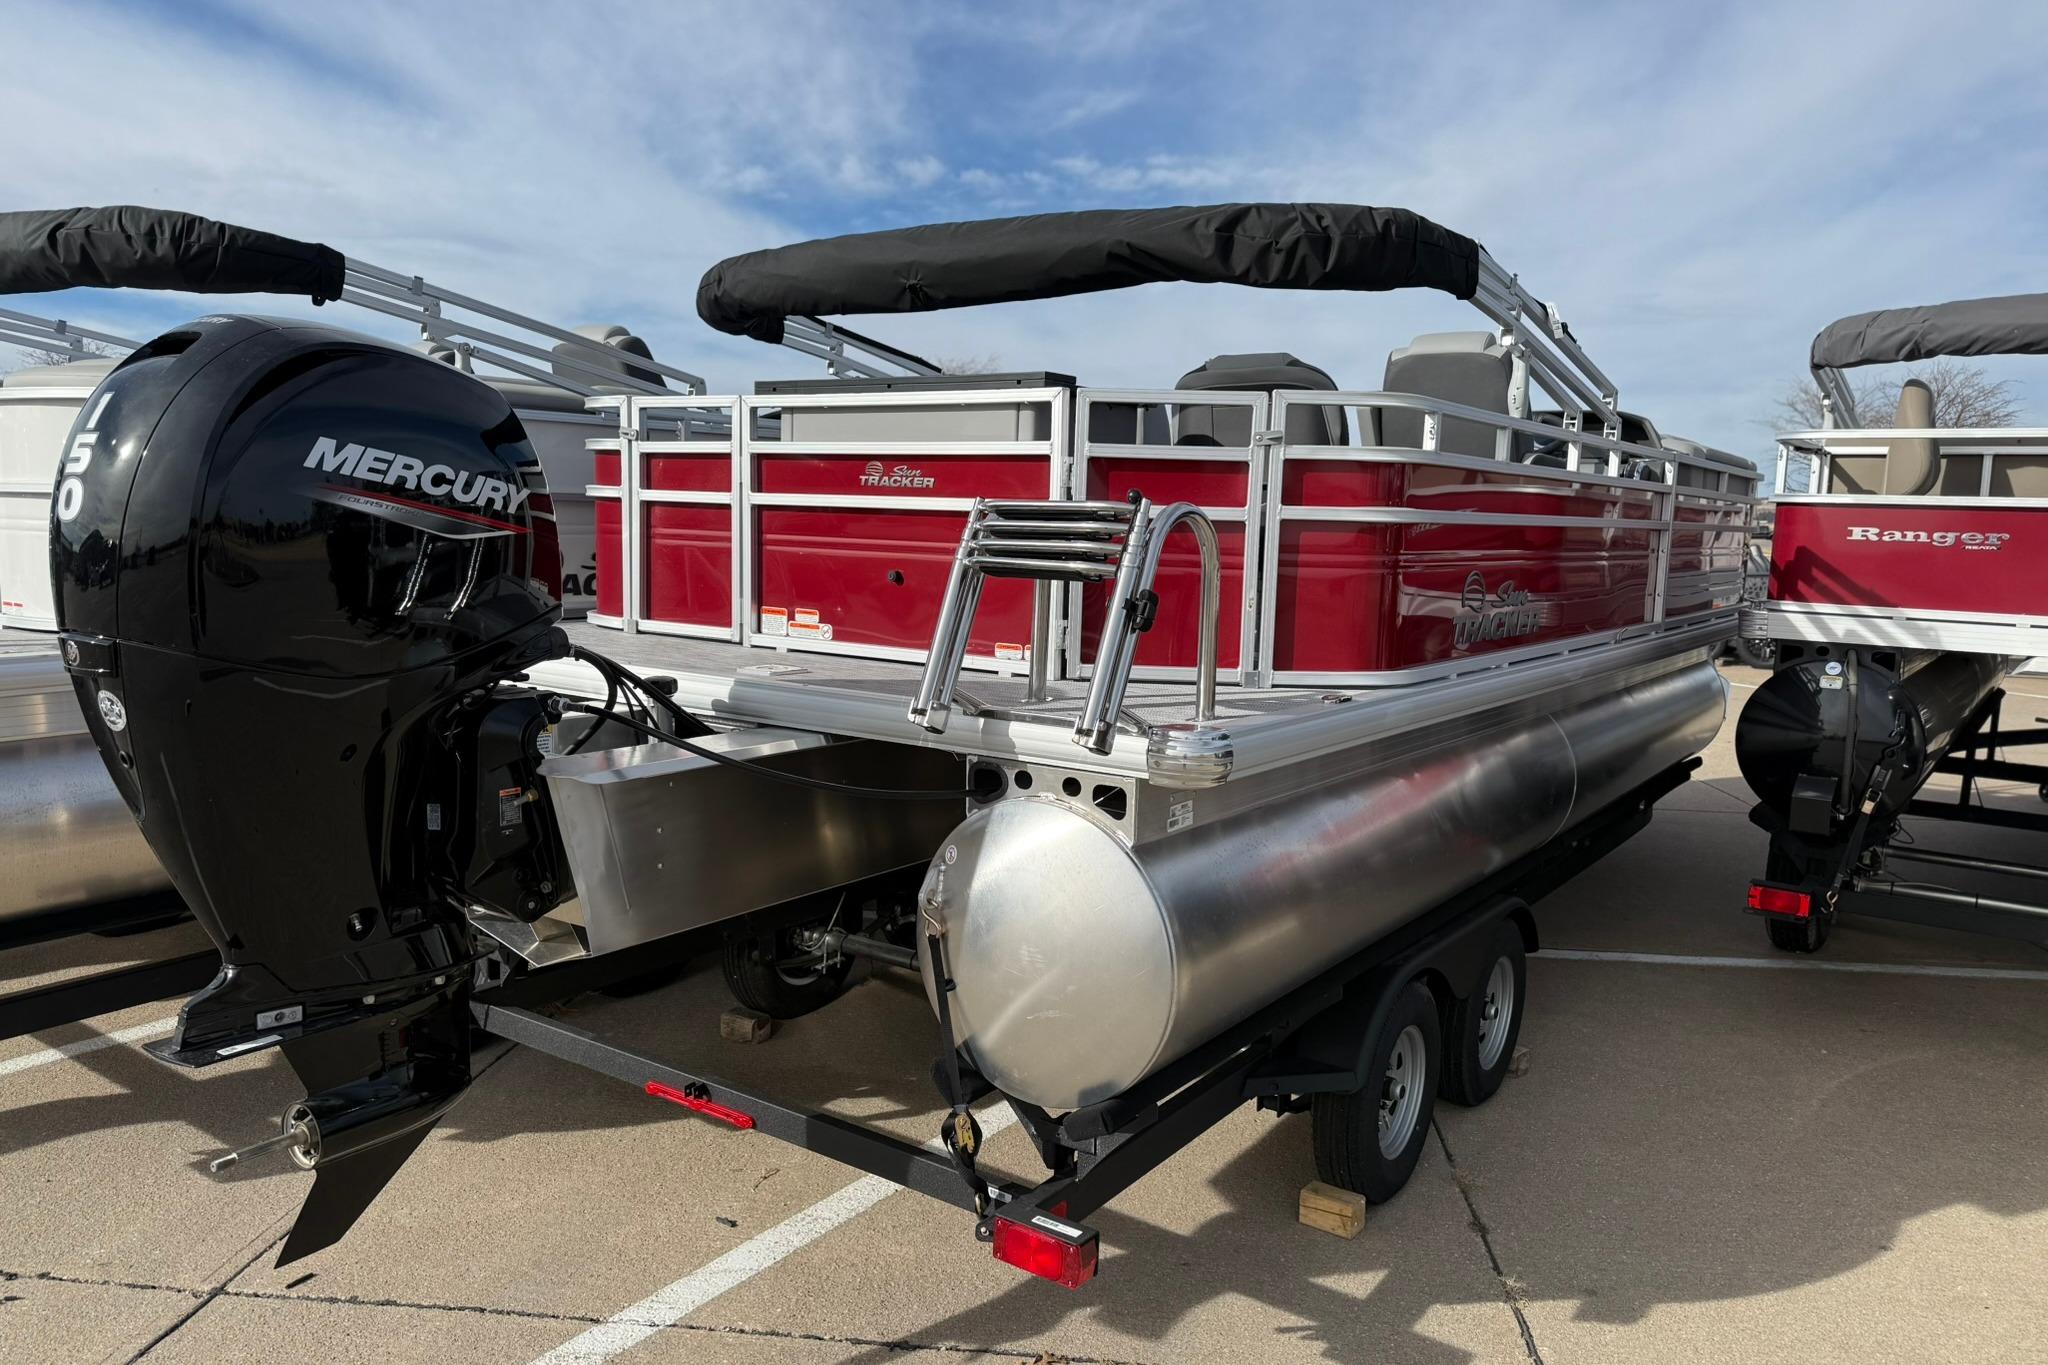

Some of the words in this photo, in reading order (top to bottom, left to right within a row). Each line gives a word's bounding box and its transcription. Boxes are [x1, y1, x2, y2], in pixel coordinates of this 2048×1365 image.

[58, 391, 115, 522] 150
[303, 436, 532, 514] MERCURY
[859, 475, 935, 488] TRACKER
[889, 464, 922, 477] Sun
[338, 494, 424, 517] FOURSTROK
[1846, 526, 2010, 546] Ranger
[1490, 580, 1529, 608] Sun
[1453, 606, 1540, 646] TRACKER
